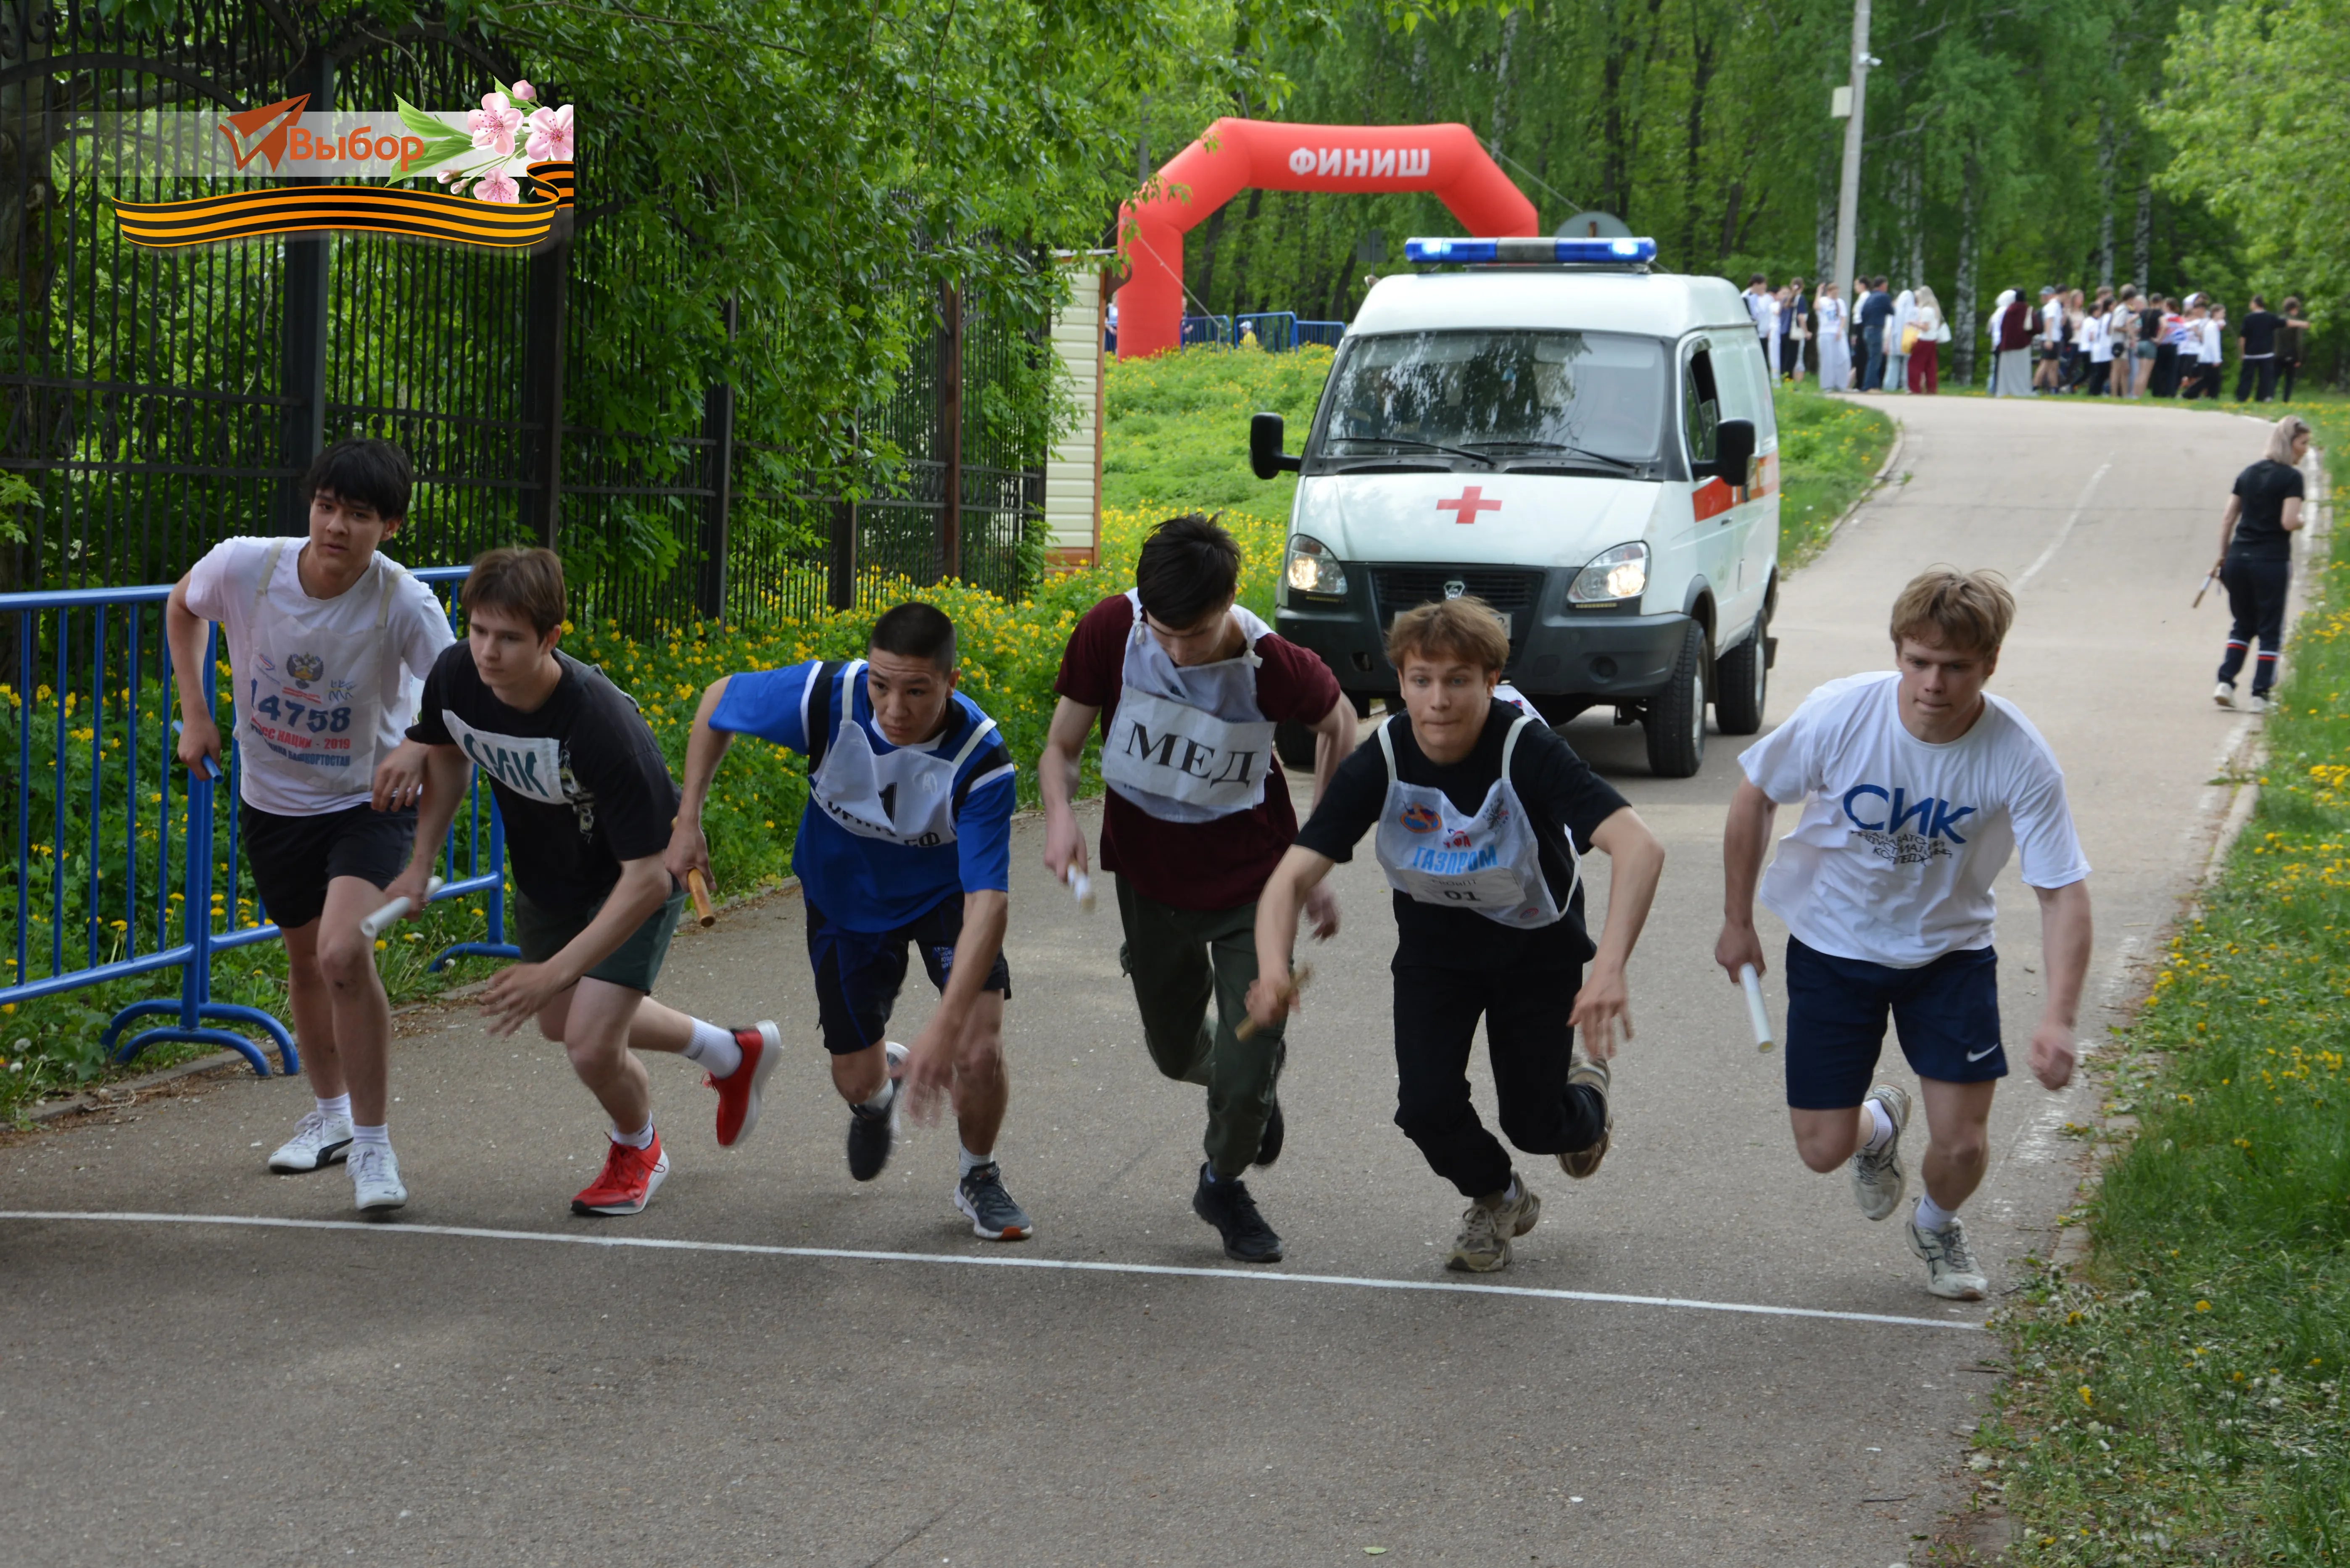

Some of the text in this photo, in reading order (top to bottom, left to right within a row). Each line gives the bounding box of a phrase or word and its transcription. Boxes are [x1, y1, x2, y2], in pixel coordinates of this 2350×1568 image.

[1289, 147, 1430, 177] ФИНИШ
[277, 730, 312, 749] НАЦИИ
[324, 738, 351, 749] 2019
[1122, 719, 1259, 789] МЕД
[288, 750, 351, 767] БАШКОРТОСТАН
[464, 733, 550, 798] СИК
[878, 782, 897, 826] 1
[1843, 784, 1978, 844] СИК
[1412, 845, 1498, 875] ГАЗПРОМ
[1443, 890, 1481, 901] 01
